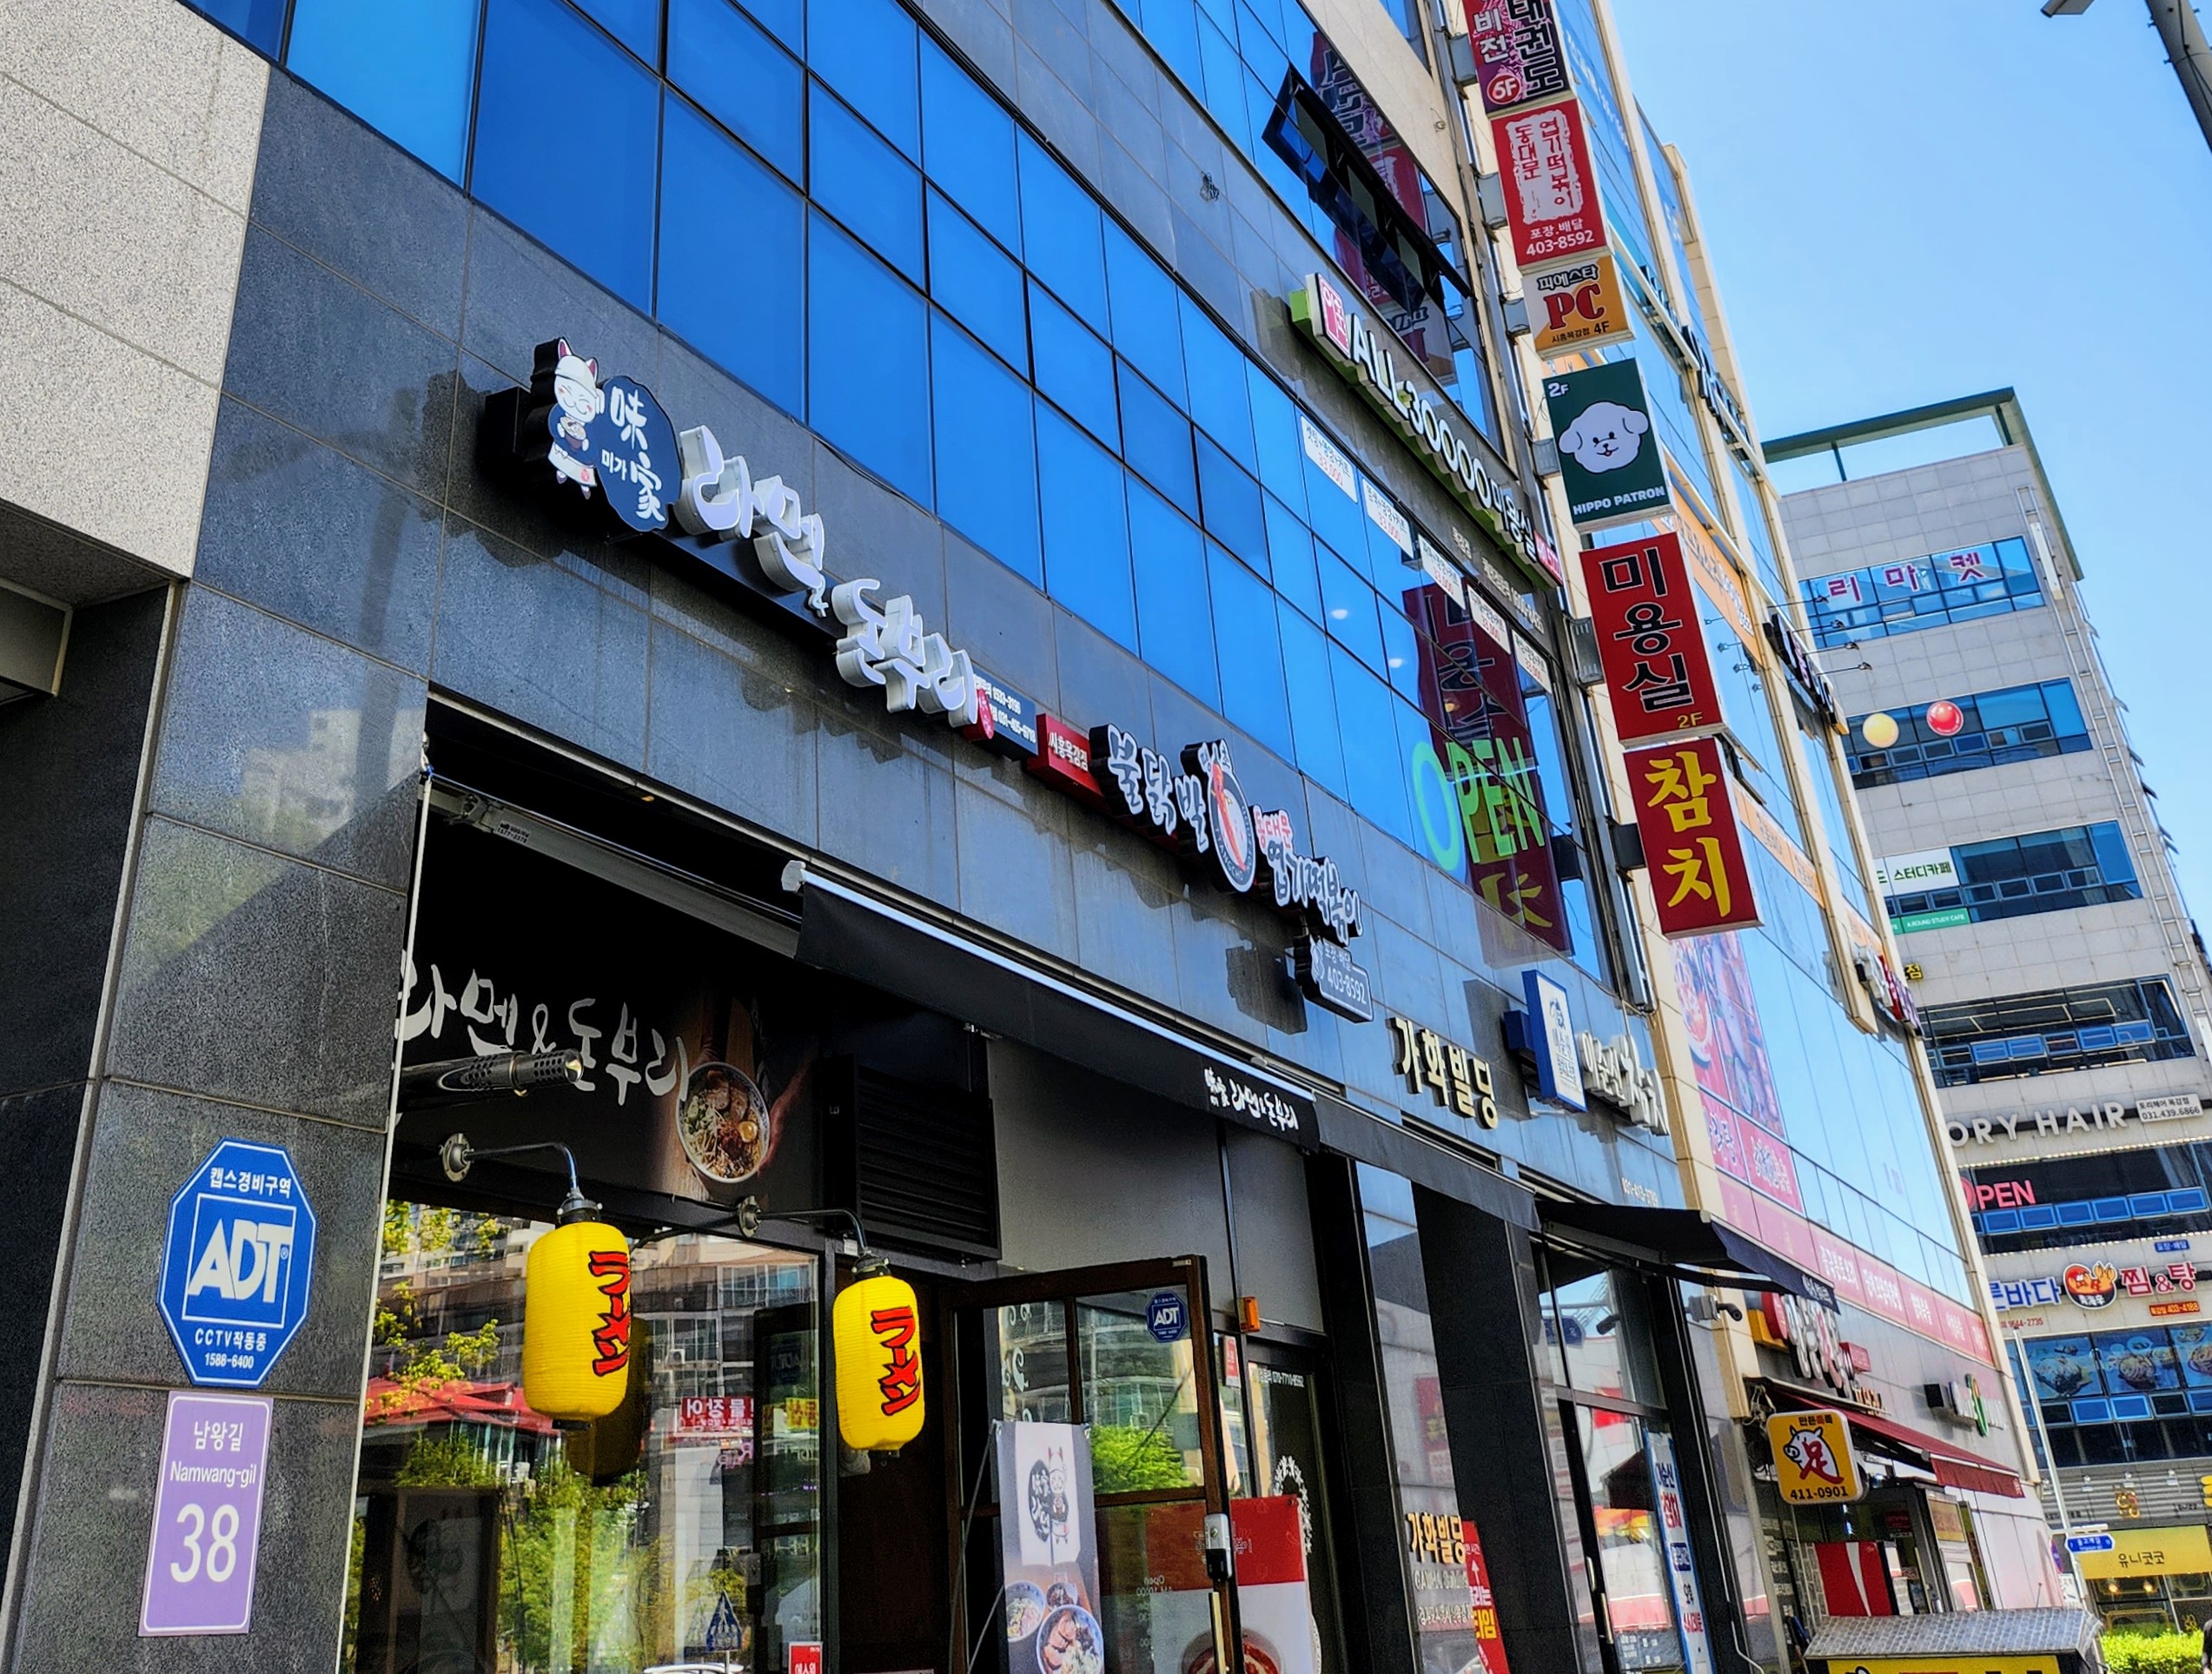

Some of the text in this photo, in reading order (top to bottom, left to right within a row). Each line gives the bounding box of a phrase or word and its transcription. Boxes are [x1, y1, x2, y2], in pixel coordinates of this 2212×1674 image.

[1474, 8, 1509, 63] 비전
[1506, 0, 1564, 98] 태권도
[1492, 77, 1517, 99] 6F
[1515, 122, 1541, 181] 동대문
[1540, 117, 1577, 209] 엽기떡볶이
[1526, 230, 1595, 256] 403-8592
[1537, 263, 1599, 291] 피에스타
[1543, 282, 1606, 331] PC
[1593, 321, 1609, 334] 4F
[1548, 382, 1569, 398] 2F
[601, 448, 628, 480] 미가
[1573, 486, 1666, 516] HIPPO PATRON
[1599, 546, 1694, 714] 미용실
[1677, 711, 1704, 730] 2F
[1413, 737, 1546, 871] OPEN
[1255, 808, 1292, 850] 동대문
[1645, 751, 1732, 918] 참치
[1894, 861, 1952, 881] 스터디카페
[1268, 839, 1362, 946] 엽기떡볶이
[1328, 966, 1367, 1005] 403-8592
[1390, 1016, 1499, 1129] 가화빌딩
[2035, 1101, 2128, 1137] HAIR
[2142, 1107, 2200, 1121] 031.439.6866
[210, 1167, 292, 1198] 캡스경비구역
[188, 1218, 292, 1303] ADT
[1154, 1307, 1179, 1327] ADT
[204, 1352, 255, 1370] 1588-6400
[870, 1305, 921, 1417] ラーメン
[193, 1420, 244, 1453] 남왕길
[170, 1459, 256, 1487] Namwang-gil
[1790, 1486, 1849, 1499] 411-0901
[170, 1503, 239, 1584] 38
[1408, 1512, 1467, 1565] 가화빌딩
[2118, 1551, 2165, 1569] 유니코코
